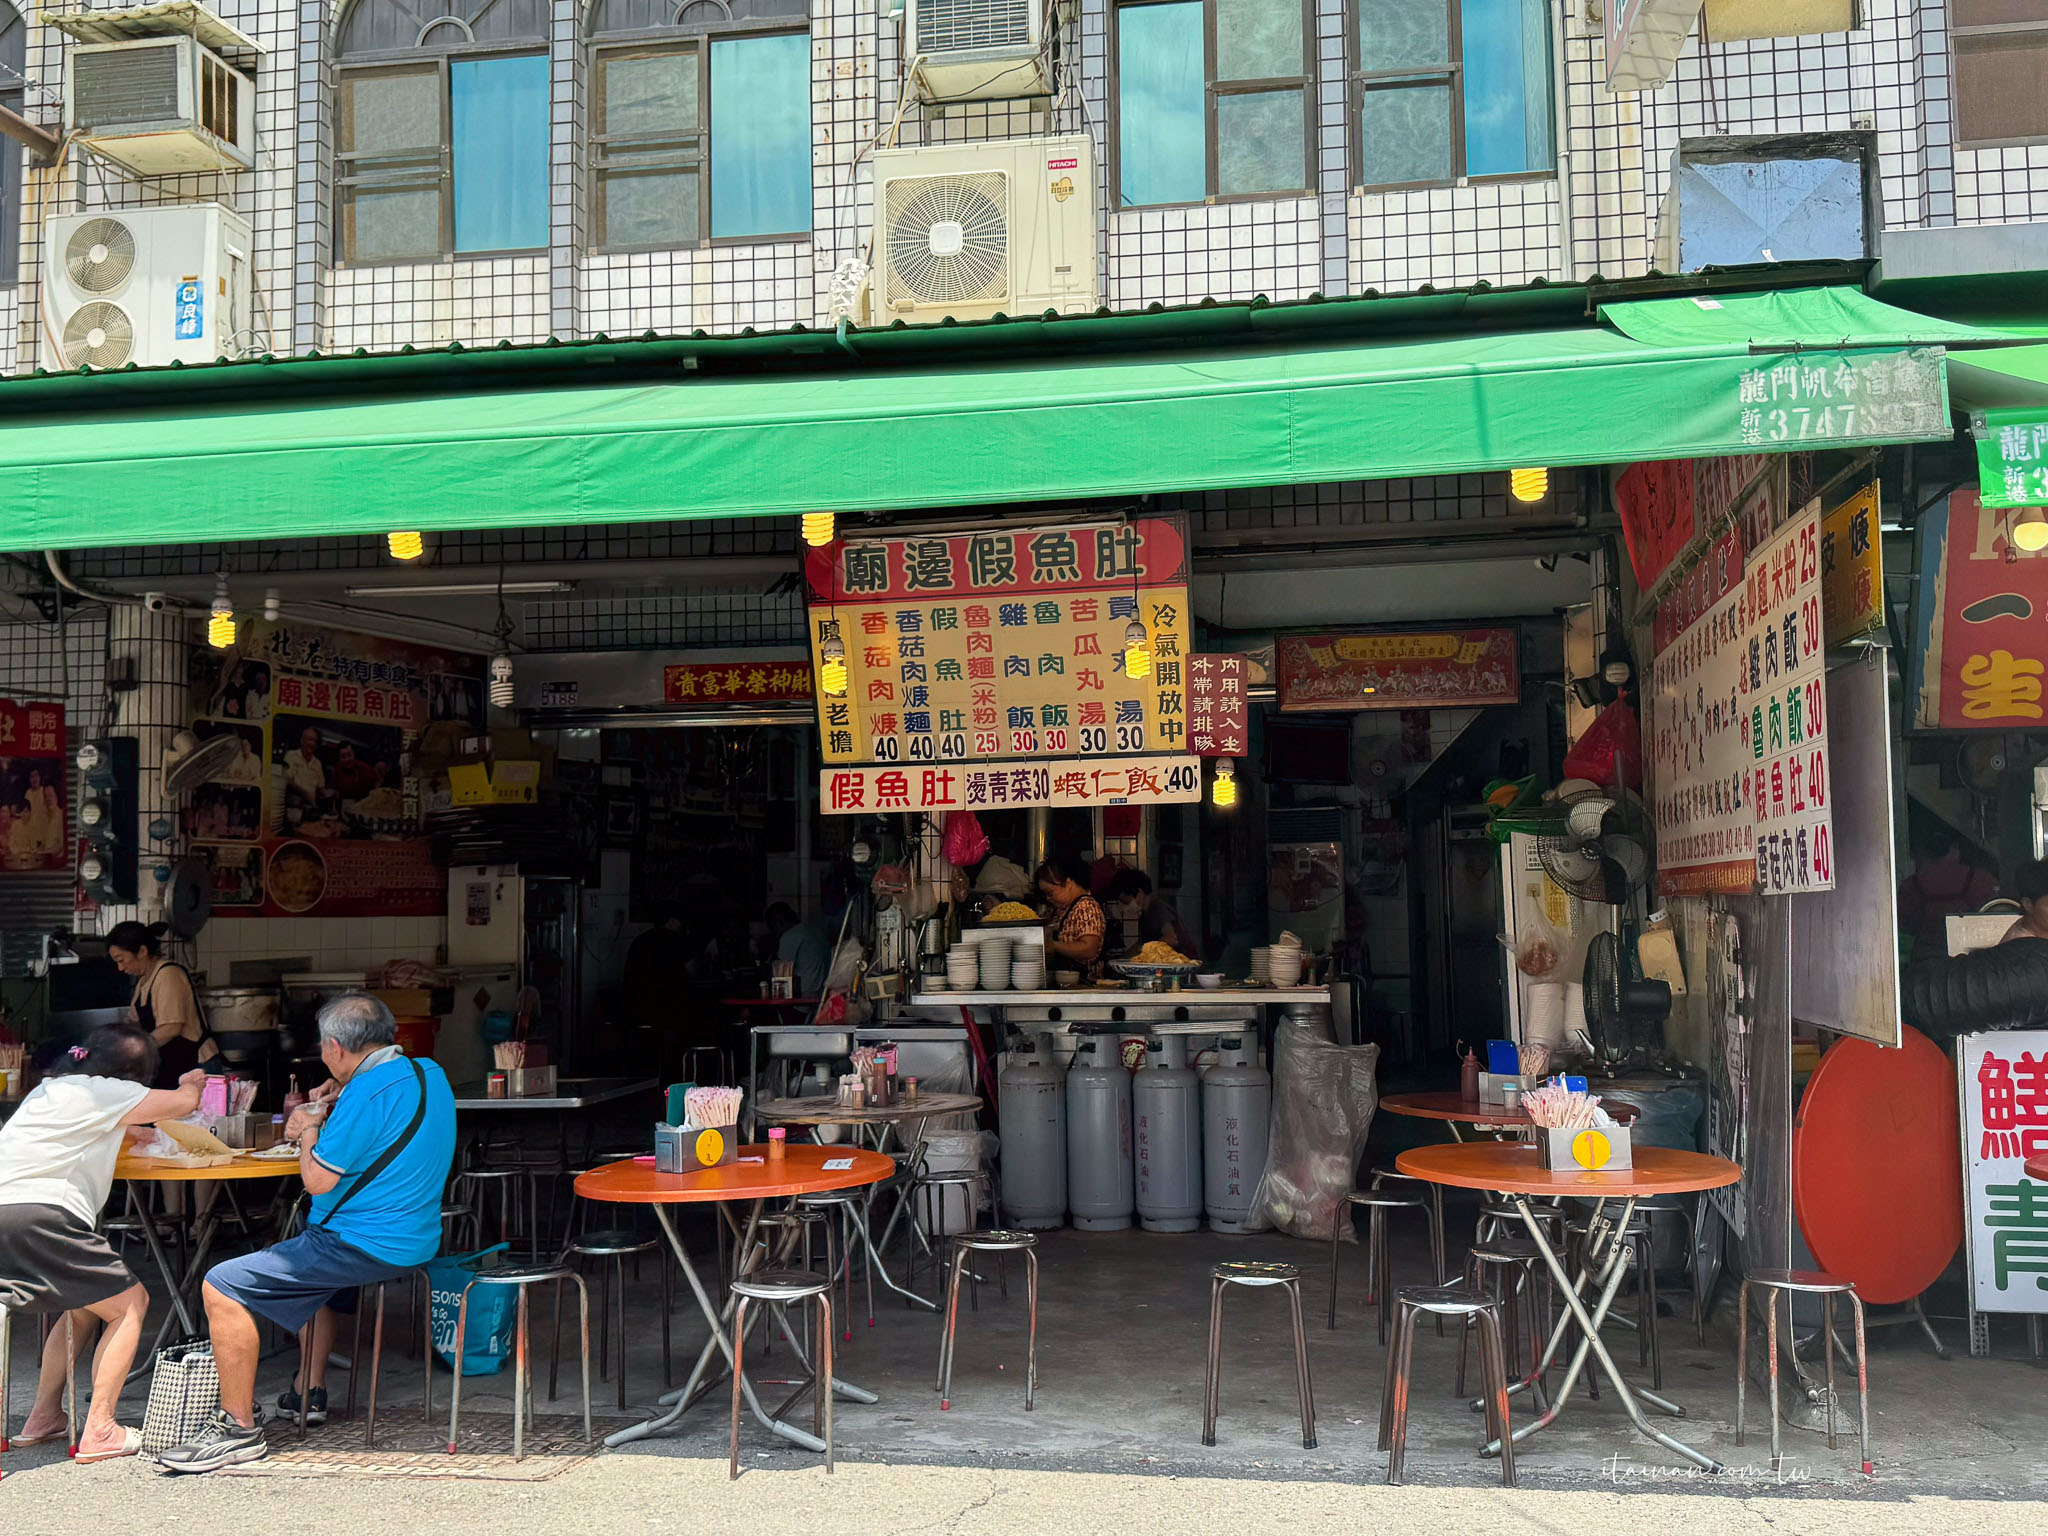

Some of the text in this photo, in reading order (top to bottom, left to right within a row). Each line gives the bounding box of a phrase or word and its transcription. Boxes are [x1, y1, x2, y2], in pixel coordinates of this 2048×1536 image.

[843, 529, 1146, 593] 廟邊假魚肚
[1800, 521, 1816, 584] 25
[333, 655, 409, 684] 特有美食
[1033, 601, 1069, 750] 魯肉飯 30
[1070, 598, 1107, 752] 苦瓜丸湯 30
[1152, 603, 1182, 743] 冷氣開放中
[1749, 595, 1818, 695] 雞肉飯 30
[277, 678, 412, 721] 廟邊假魚肚
[930, 607, 967, 758] 假魚肚 40
[999, 603, 1034, 751] 雞肉飯 30
[1192, 656, 1216, 752] 外帶請排隊
[875, 737, 898, 760] 40
[909, 736, 933, 759] 40
[975, 733, 996, 753] 25
[1117, 726, 1144, 751] 30
[1752, 679, 1822, 759] 魯肉飯 30
[830, 769, 956, 809] 假魚肚
[1053, 765, 1193, 800] 蝦仁飯 40
[1755, 750, 1824, 824] 假魚肚 40
[1744, 825, 1752, 852] 40
[1814, 824, 1829, 882] 40
[1226, 1118, 1240, 1196] 液化石油氣
